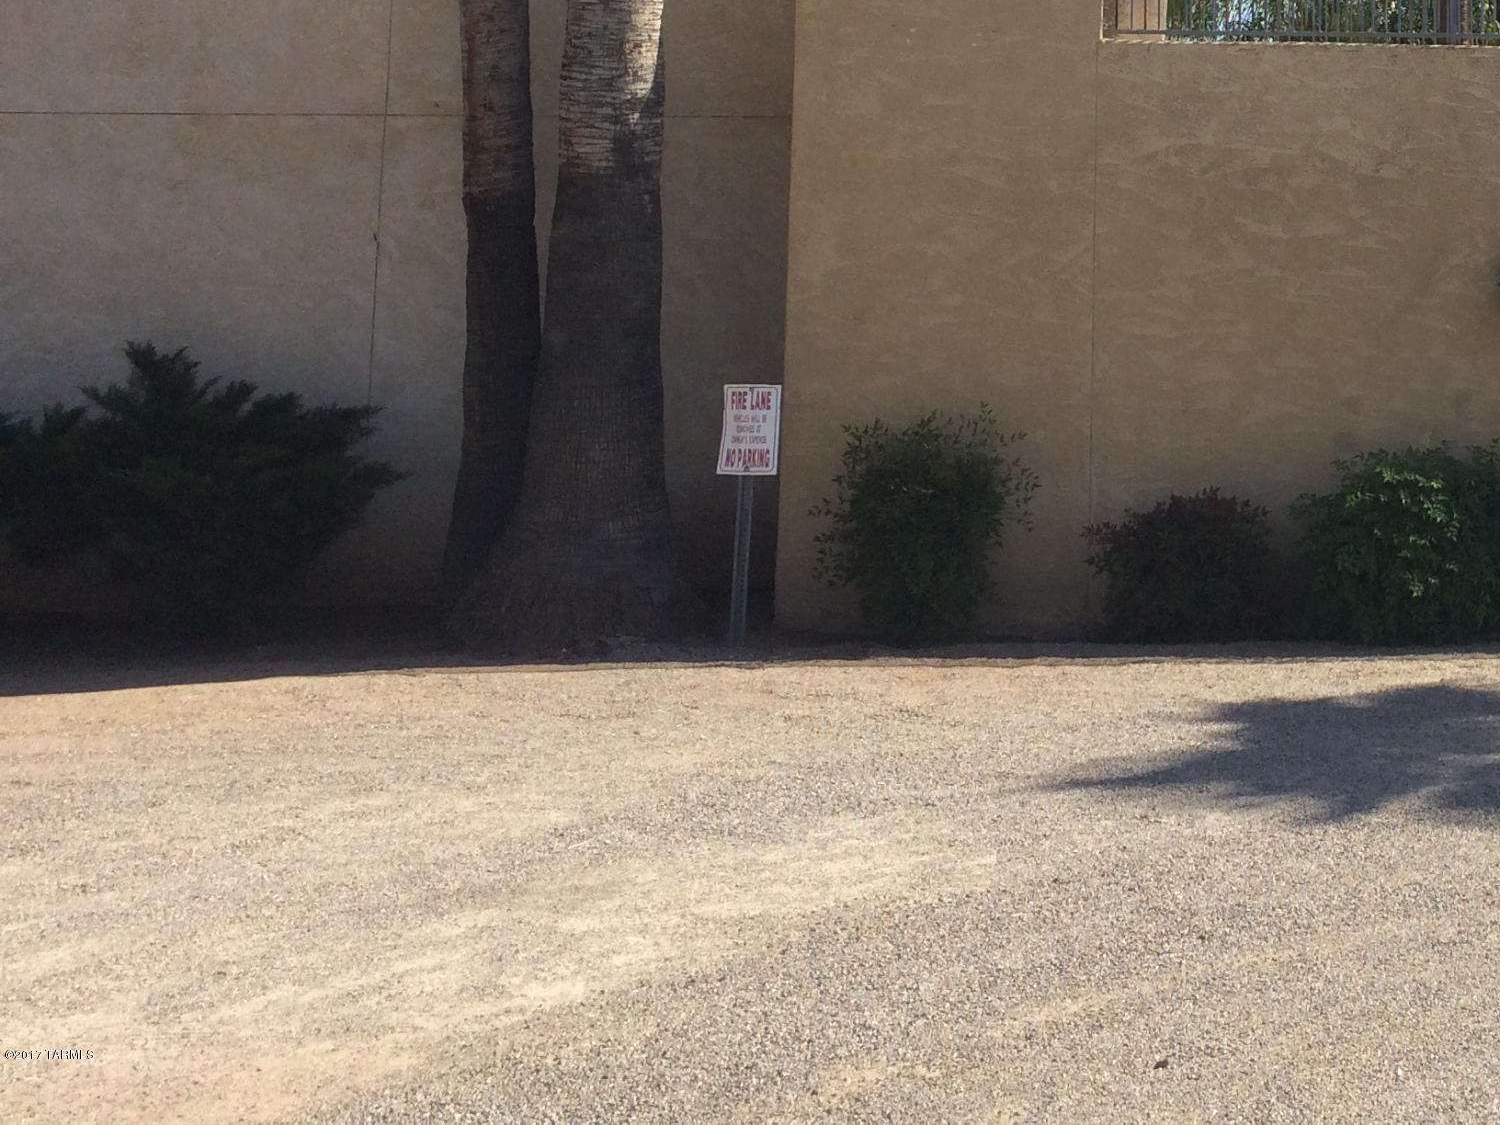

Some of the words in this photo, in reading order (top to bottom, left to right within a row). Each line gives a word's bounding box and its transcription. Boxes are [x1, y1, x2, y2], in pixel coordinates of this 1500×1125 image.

[731, 391, 748, 410] FIRE
[750, 391, 771, 410] LANE
[725, 449, 736, 468] NO
[737, 448, 770, 468] PARKING
